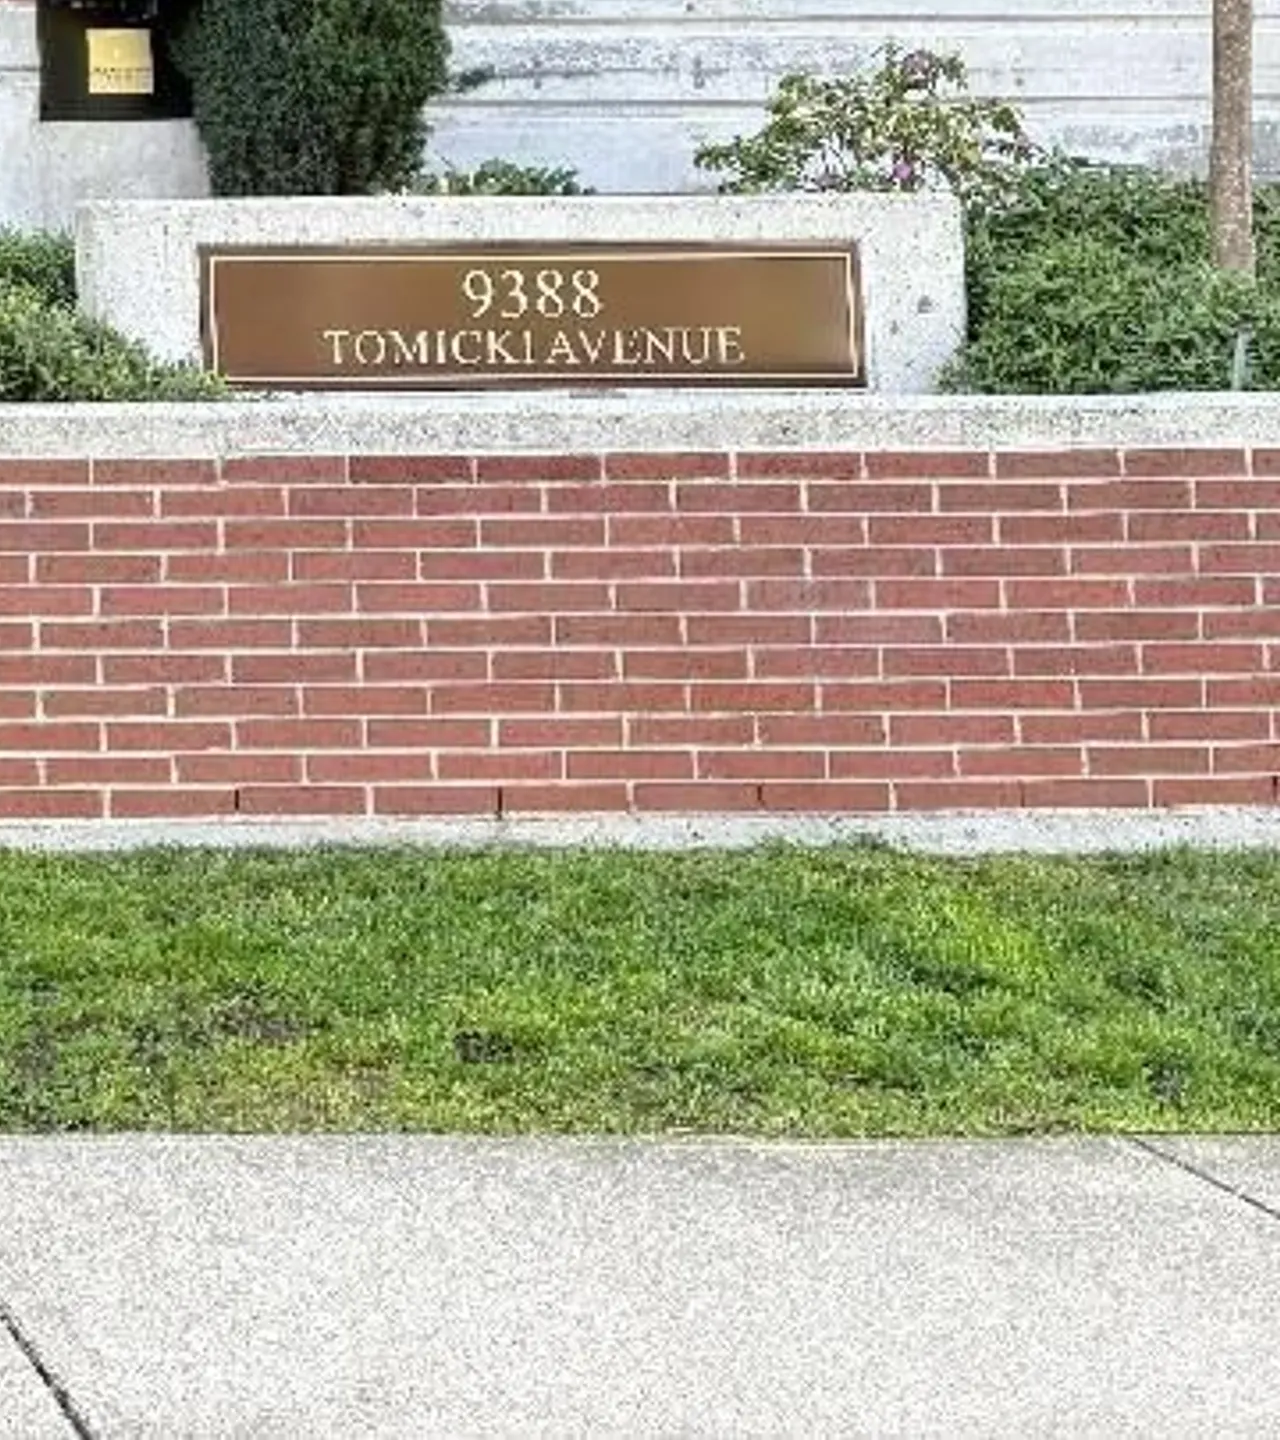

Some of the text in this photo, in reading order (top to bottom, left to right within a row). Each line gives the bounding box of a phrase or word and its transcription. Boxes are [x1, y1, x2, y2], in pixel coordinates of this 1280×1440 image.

[462, 268, 604, 319] 9388
[322, 326, 746, 365] TOMICKI AVENUE
